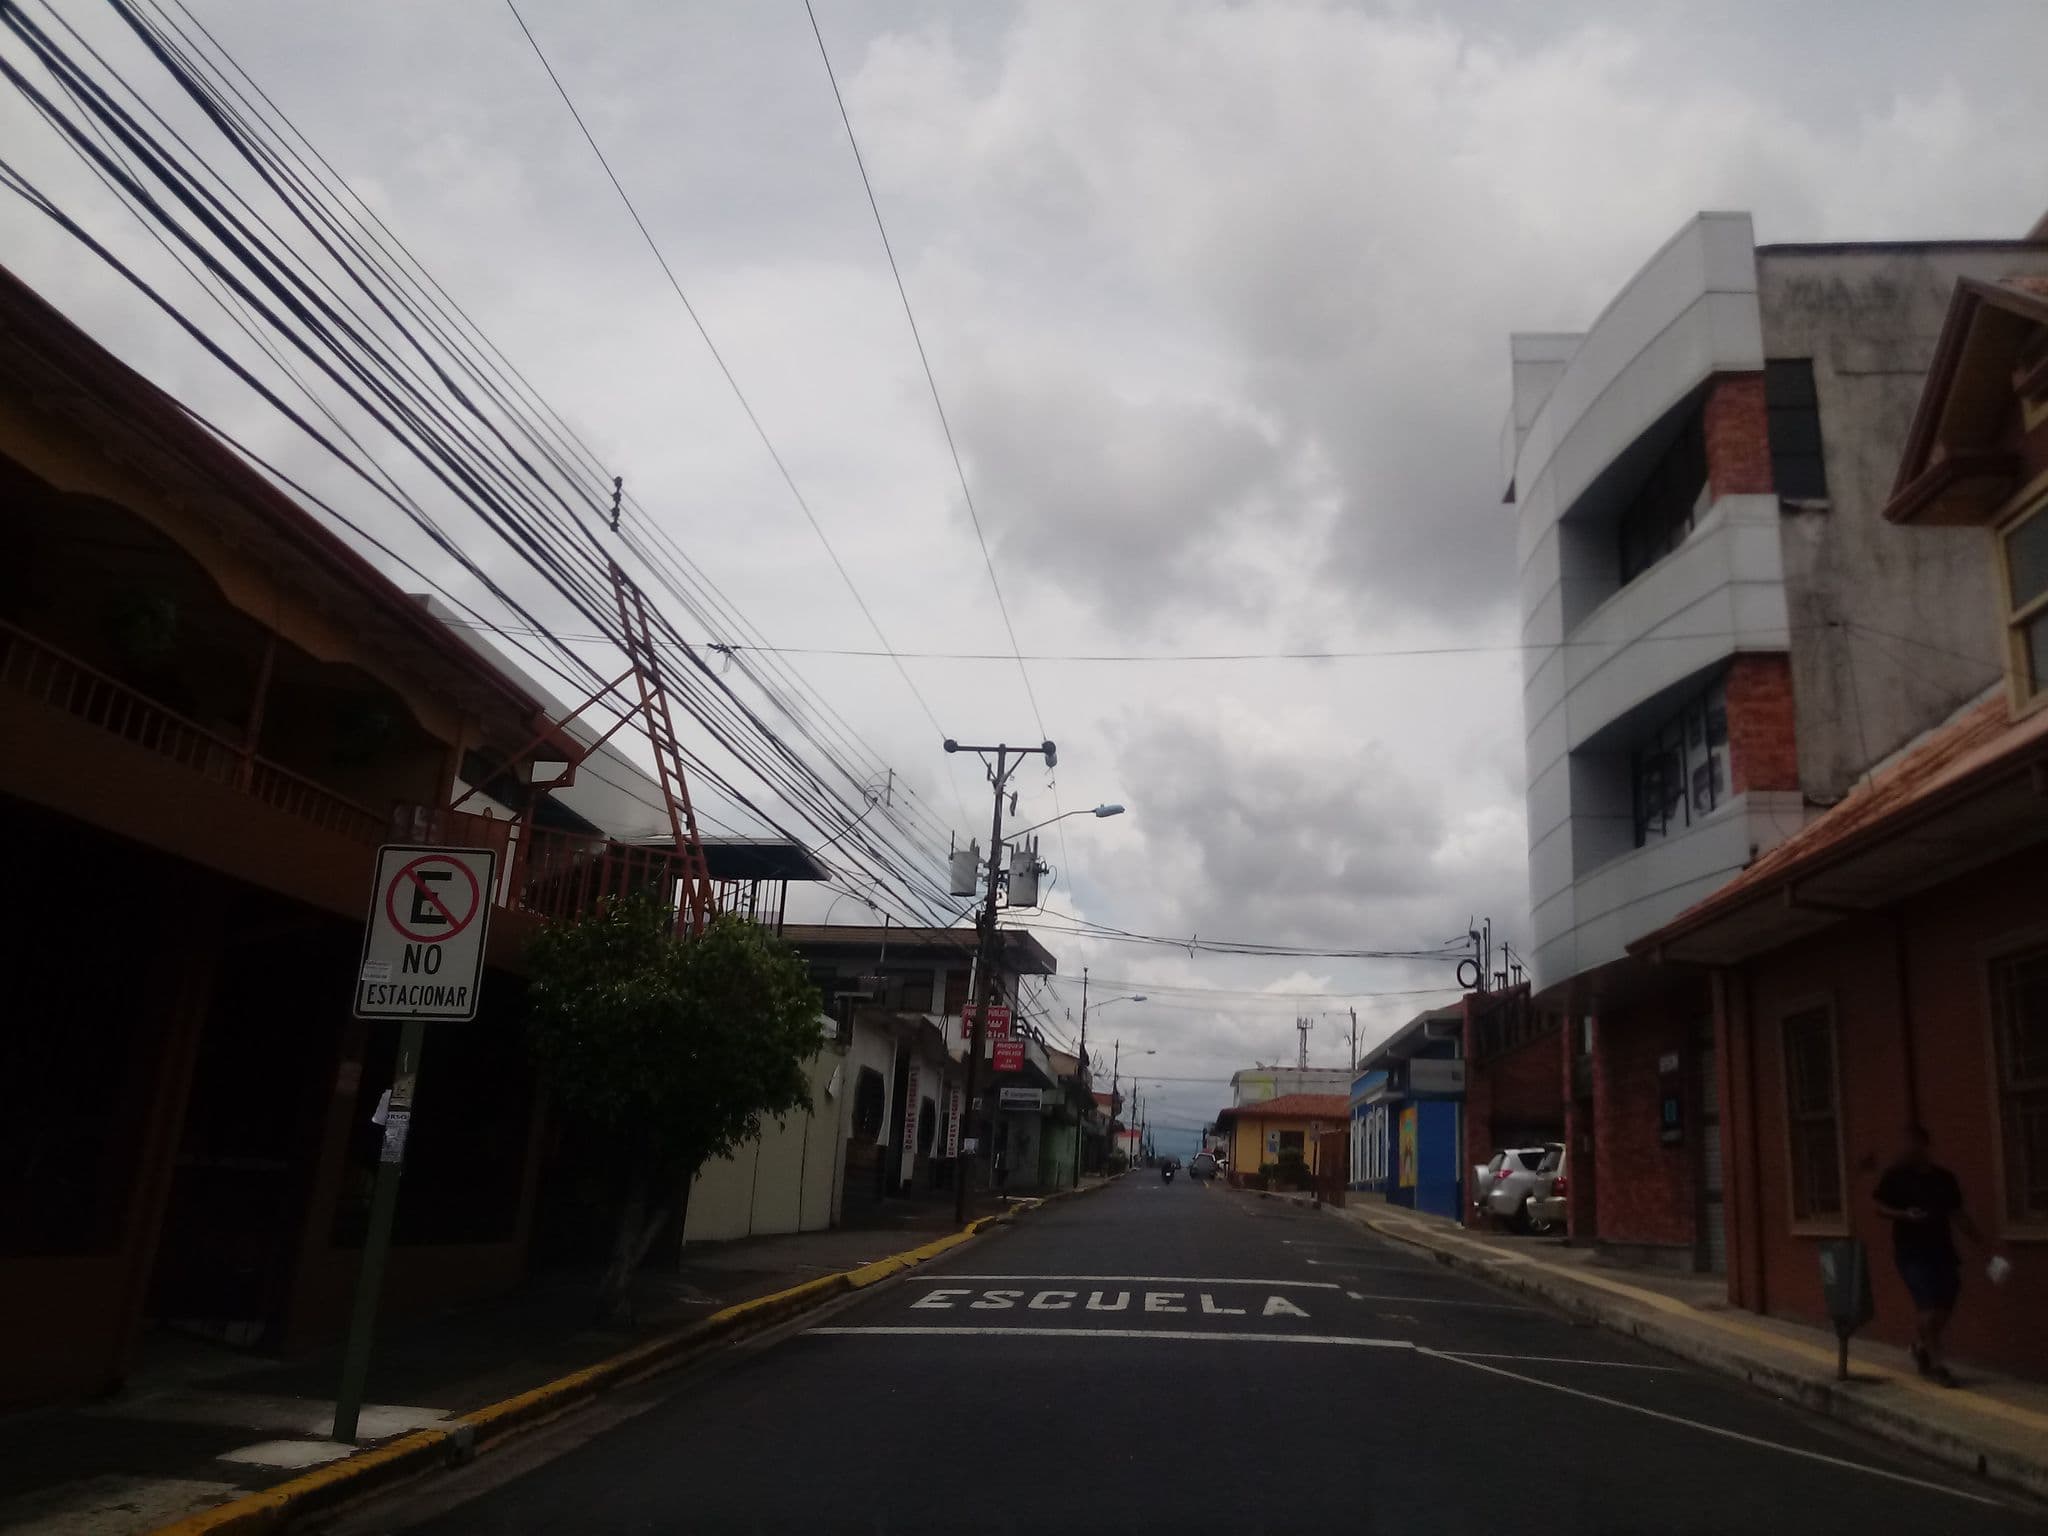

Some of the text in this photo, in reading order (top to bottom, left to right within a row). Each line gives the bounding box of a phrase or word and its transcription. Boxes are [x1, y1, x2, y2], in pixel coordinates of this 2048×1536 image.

[409, 870, 453, 924] E
[402, 944, 442, 976] NO
[366, 984, 468, 1008] ESTACIONAR
[908, 1288, 1311, 1318] ESCUELA
